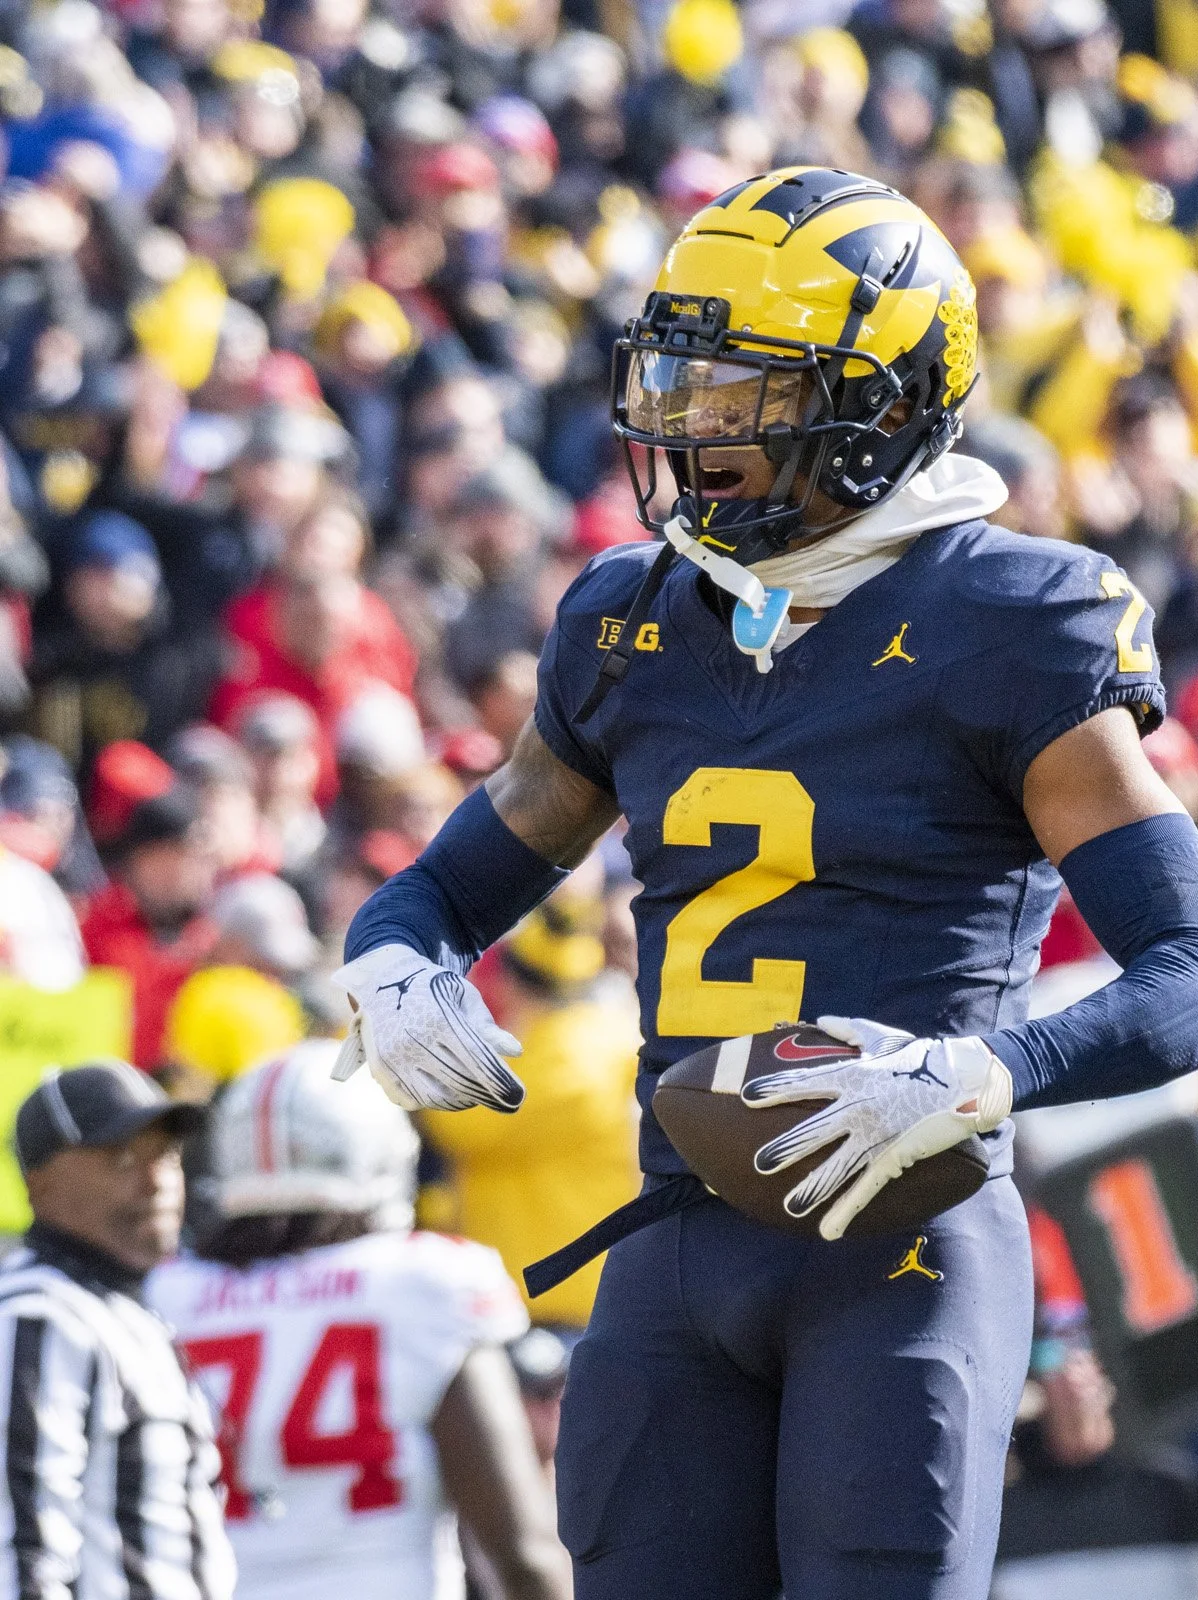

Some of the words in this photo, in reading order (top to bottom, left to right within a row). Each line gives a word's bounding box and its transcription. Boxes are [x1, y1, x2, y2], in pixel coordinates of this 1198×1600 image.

[597, 616, 660, 651] BG
[1101, 572, 1153, 673] 2
[656, 767, 816, 1037] 2
[183, 1322, 402, 1521] 74
